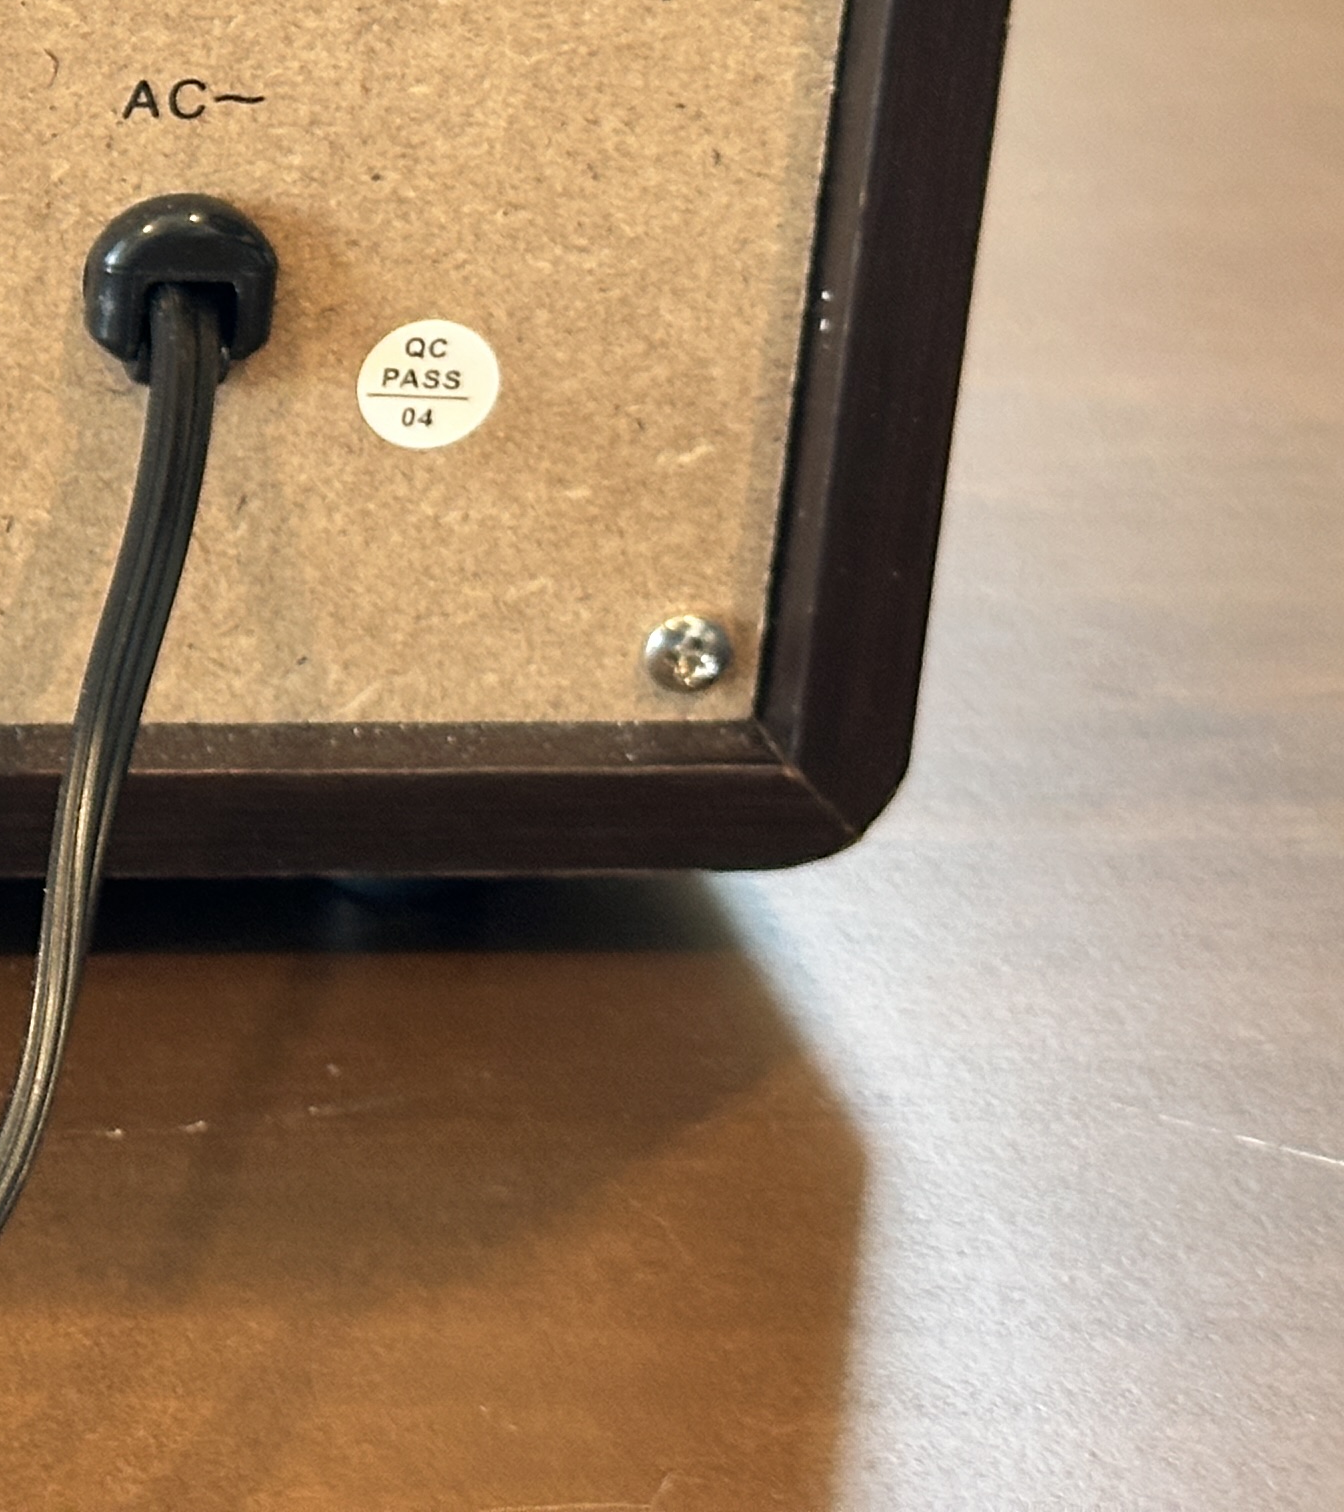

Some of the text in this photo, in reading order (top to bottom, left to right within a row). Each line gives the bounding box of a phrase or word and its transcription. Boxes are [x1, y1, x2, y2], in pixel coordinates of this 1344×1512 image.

[405, 337, 448, 359] QC
[382, 367, 461, 390] PASS
[401, 407, 433, 427] 04
